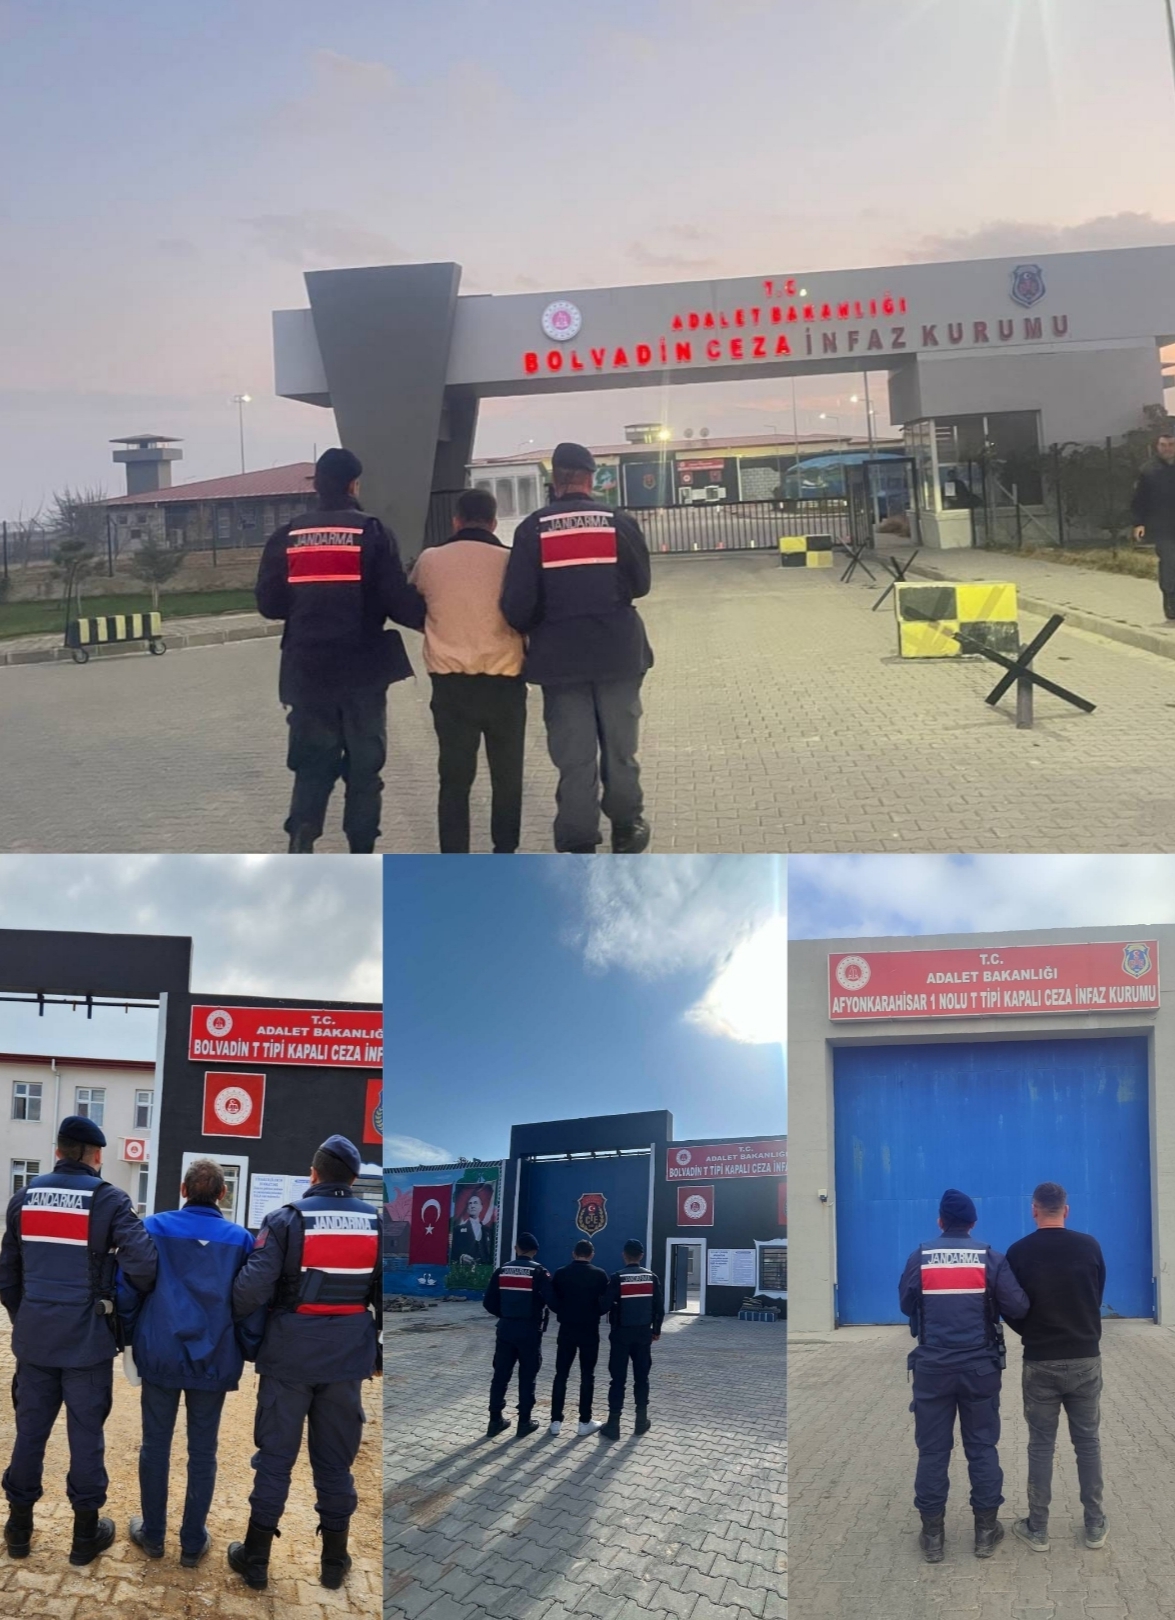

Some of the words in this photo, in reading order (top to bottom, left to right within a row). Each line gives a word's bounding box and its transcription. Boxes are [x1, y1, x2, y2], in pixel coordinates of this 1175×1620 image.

[672, 308, 760, 331] ADALET
[771, 290, 906, 324] BAKANLIĞI
[524, 336, 692, 374] BOLVADİN
[707, 335, 791, 360] CEZA
[805, 327, 905, 356] İNFAZ
[922, 315, 1069, 347] KURUMU
[549, 515, 610, 531] JANDARMA
[294, 532, 354, 547] JANDARMA
[979, 953, 1004, 965] T.C.
[926, 971, 979, 984] ADALET
[983, 966, 1058, 982] BAKANLIĞI
[832, 991, 927, 1014] AFYONKARAHİSAR
[930, 993, 936, 1010] 1
[939, 992, 967, 1010] NOLU
[970, 992, 977, 1009] T
[980, 987, 1001, 1008] TİPİ
[1004, 989, 1041, 1007] KAPALI
[1044, 989, 1072, 1006] CEZA
[1075, 984, 1106, 1004] İNFAZ
[1109, 985, 1156, 1003] KURUMU
[311, 1015, 336, 1025] T.C.
[256, 1026, 310, 1036] ADALET
[194, 1038, 249, 1057] BOLVADİN
[252, 1042, 260, 1057] T
[263, 1039, 285, 1058] TİPİ
[287, 1043, 327, 1060] KAPALI
[331, 1044, 361, 1061] CEZA
[669, 1165, 702, 1178] BOLVADİN
[710, 1163, 724, 1176] TİPİ
[725, 1164, 750, 1174] KAPALI
[752, 1162, 771, 1173] CEZA
[27, 1192, 83, 1208] JANDARMA
[313, 1216, 371, 1230] JANDARMA
[928, 1253, 980, 1265] JANDARMA
